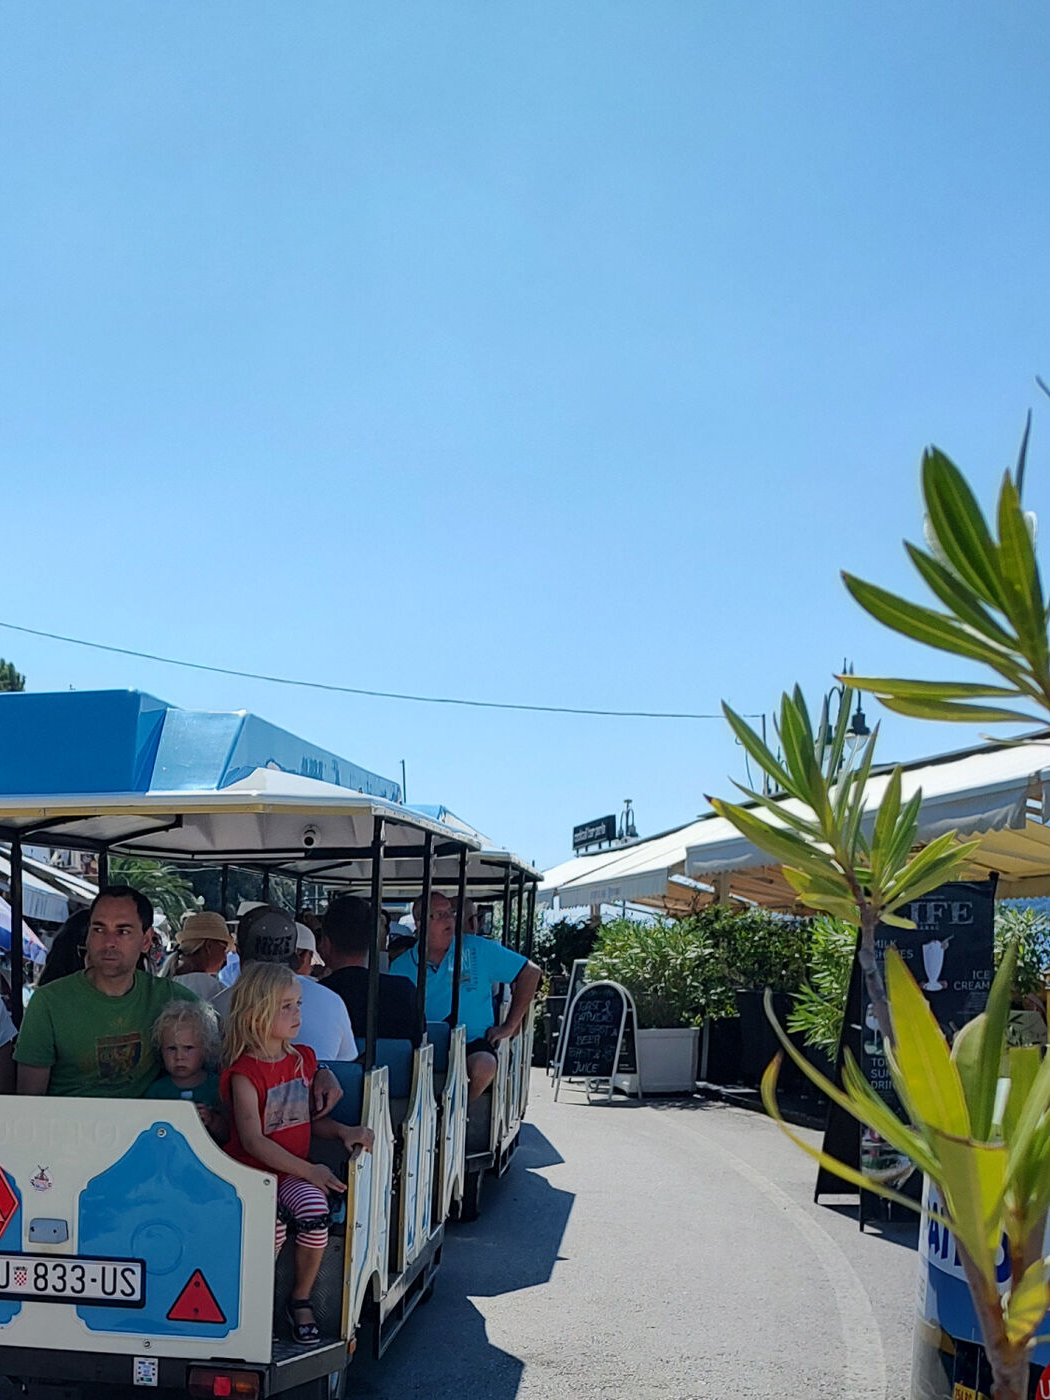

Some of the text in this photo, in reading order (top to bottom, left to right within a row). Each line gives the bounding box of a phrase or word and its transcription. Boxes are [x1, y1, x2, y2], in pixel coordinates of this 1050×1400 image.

[908, 901, 974, 925] IFE
[972, 970, 990, 979] ICE
[953, 981, 990, 990] CREAM
[33, 1261, 137, 1298] 833-US
